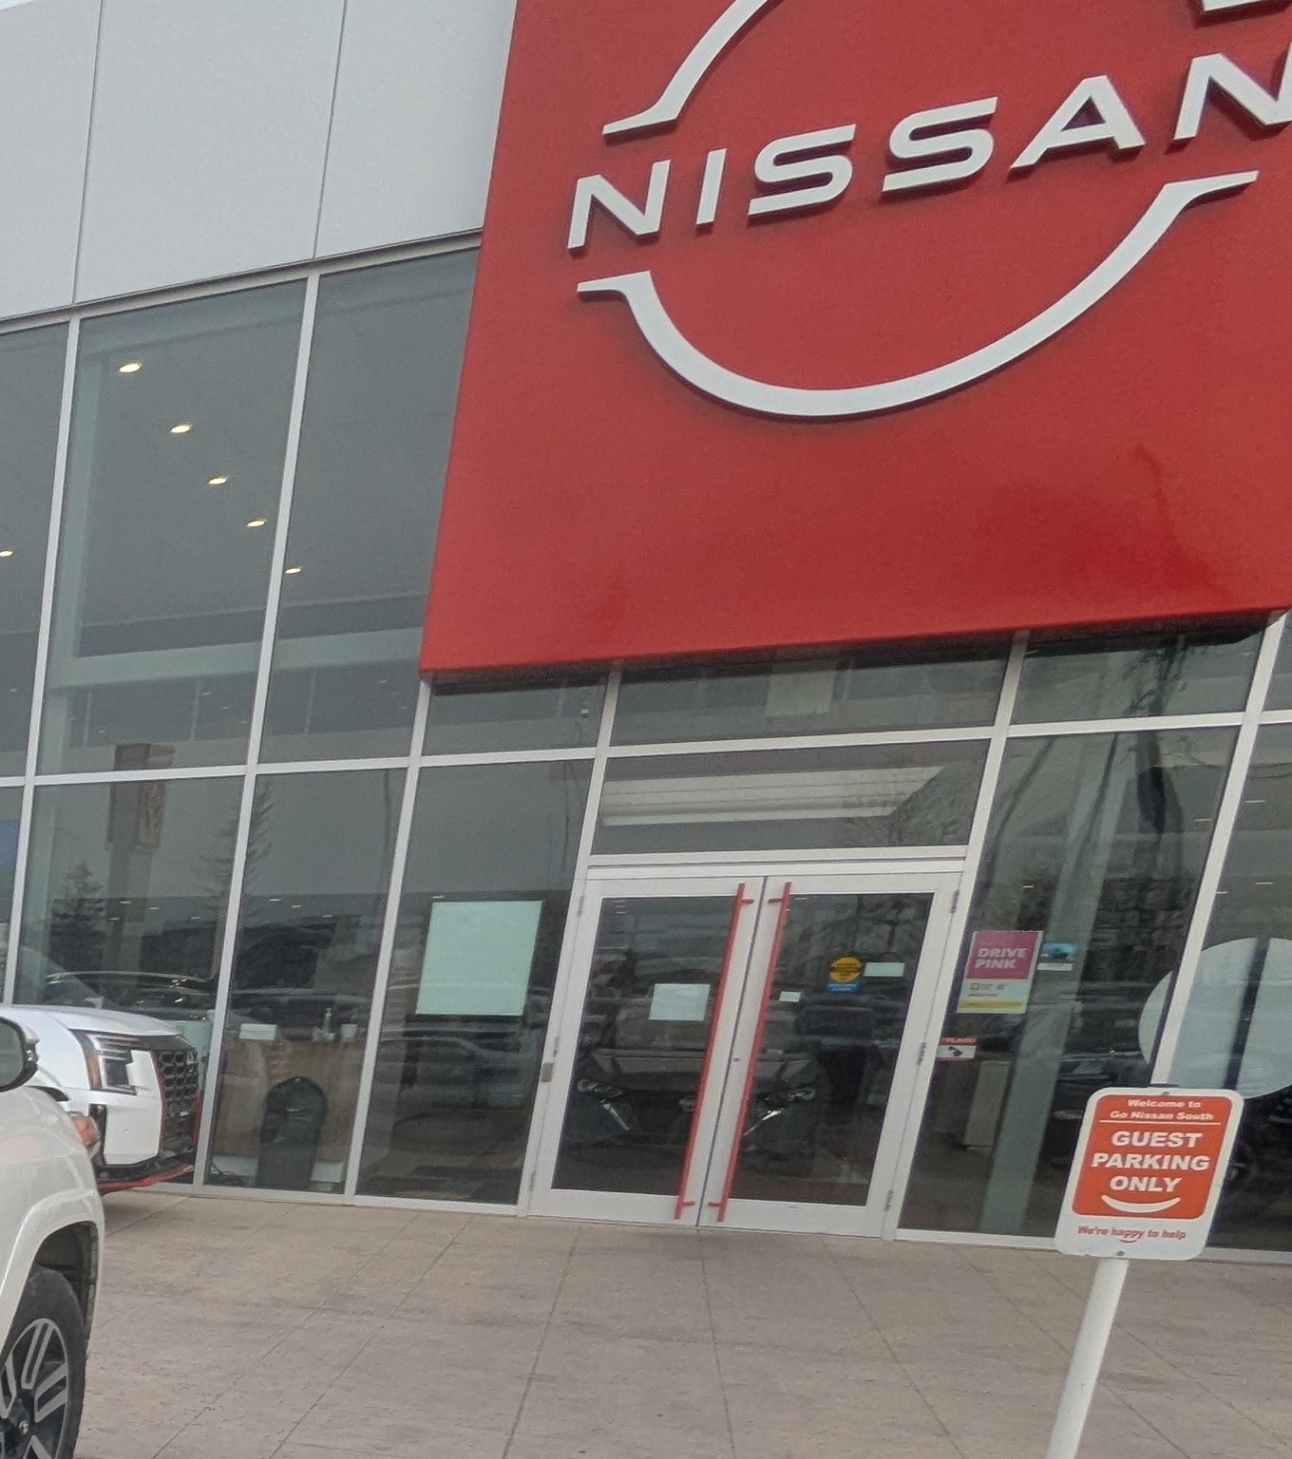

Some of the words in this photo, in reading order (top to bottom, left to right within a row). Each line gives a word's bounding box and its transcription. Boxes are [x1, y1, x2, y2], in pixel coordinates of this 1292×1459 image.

[566, 42, 1292, 250] NISSAN
[978, 947, 1028, 958] DRIVE
[975, 959, 1016, 969] PINK
[1128, 1099, 1185, 1108] Welcome
[1188, 1100, 1202, 1108] to
[1110, 1111, 1128, 1119] Go
[1130, 1111, 1174, 1120] Nissan
[1176, 1112, 1214, 1121] South
[1111, 1130, 1203, 1148] GUEST
[1091, 1152, 1210, 1171] PARKING
[1109, 1175, 1182, 1192] ONLY
[1077, 1225, 1108, 1236] We're
[1111, 1227, 1145, 1239] happy
[1147, 1229, 1159, 1238] to
[1161, 1229, 1187, 1240] help
